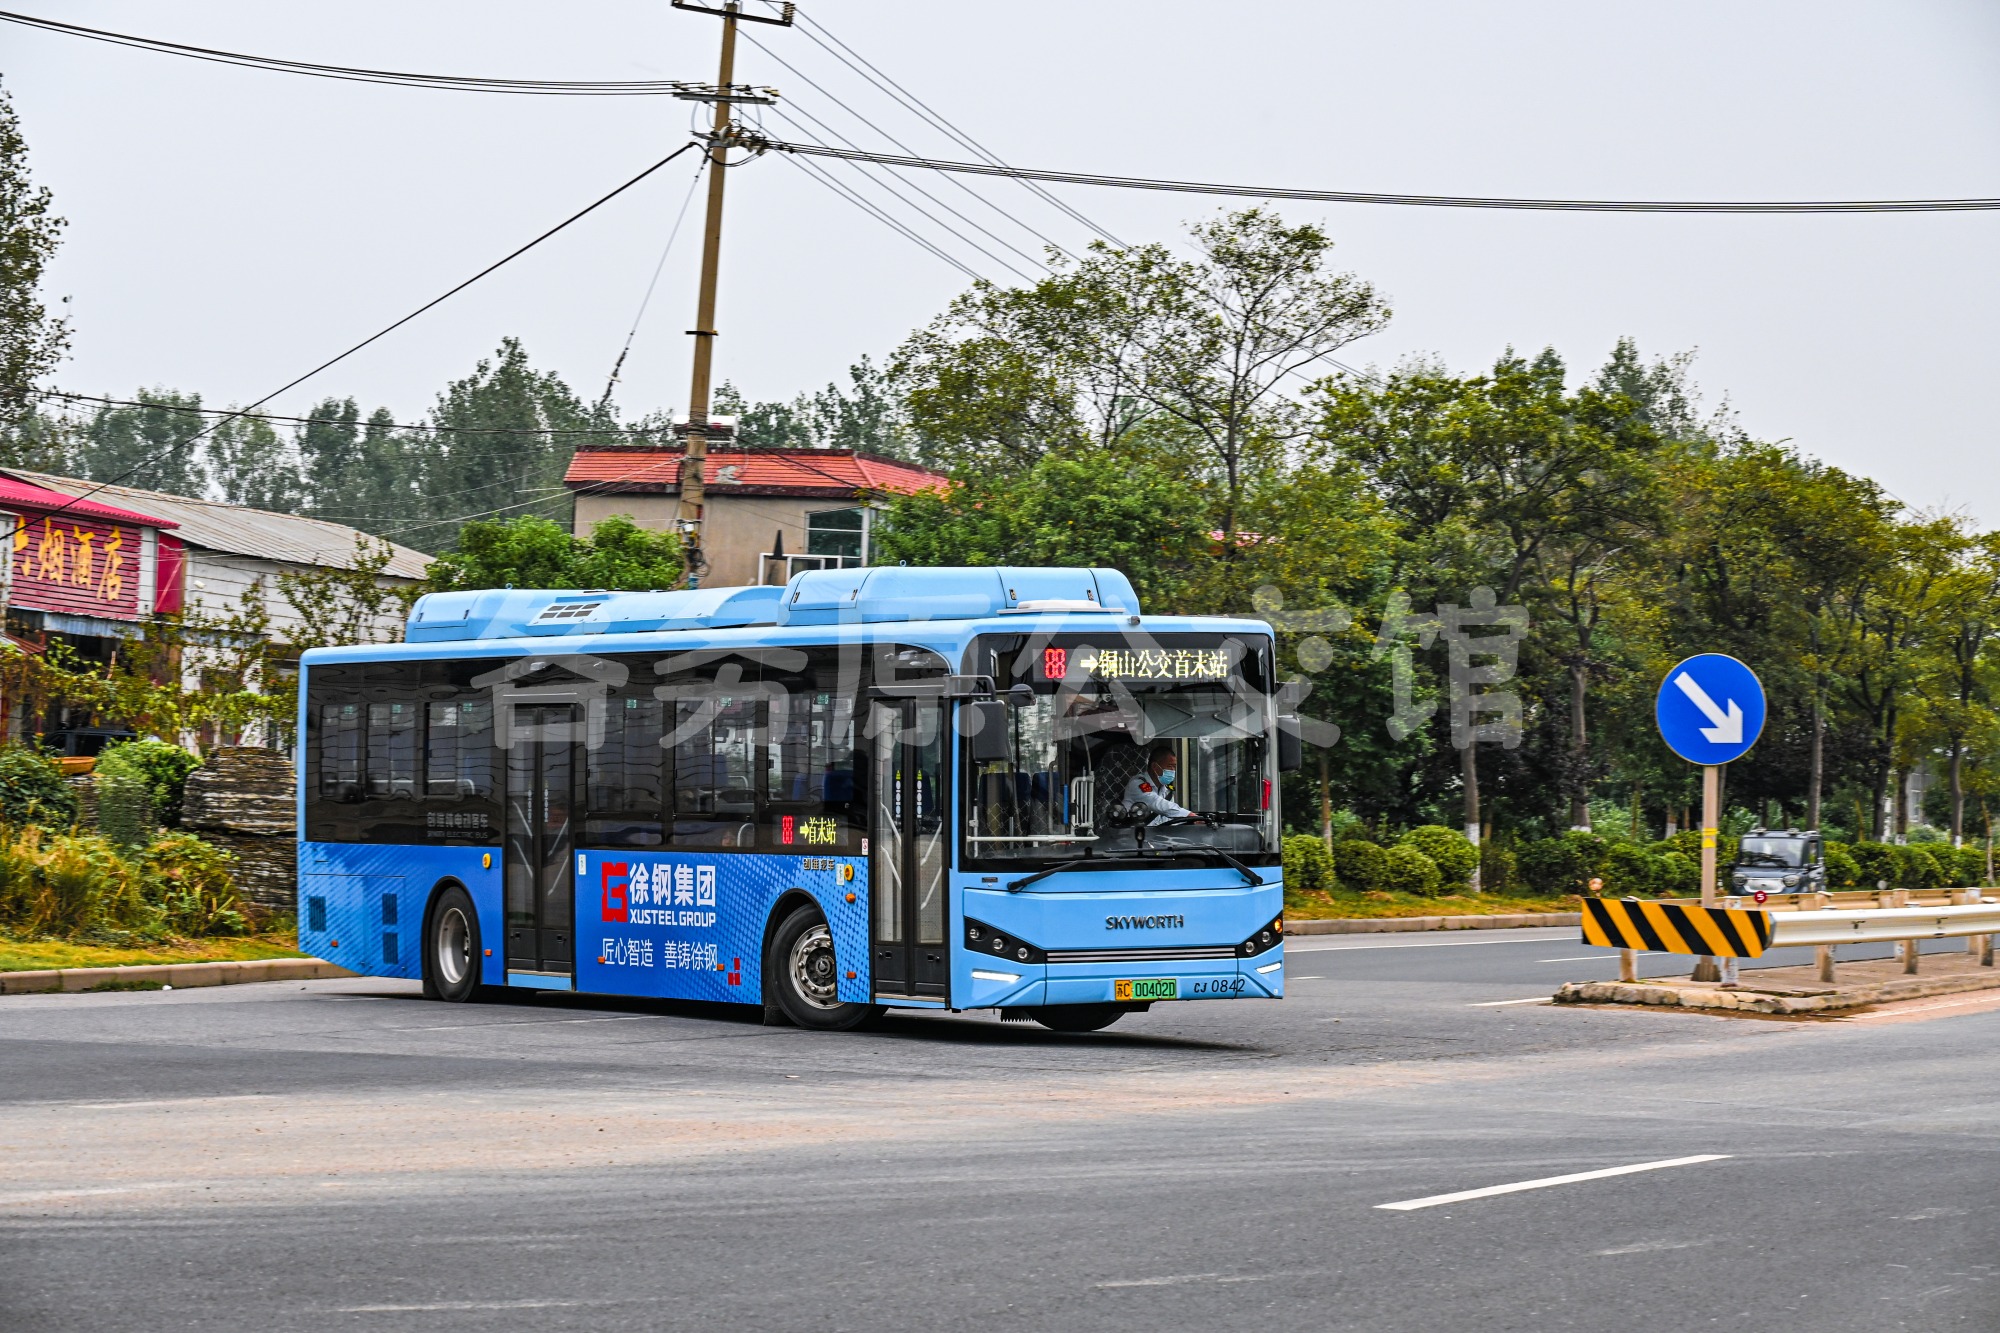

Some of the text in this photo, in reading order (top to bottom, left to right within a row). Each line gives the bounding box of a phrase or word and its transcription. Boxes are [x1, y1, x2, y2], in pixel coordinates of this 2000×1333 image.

[1045, 648, 1066, 679] 88
[782, 815, 793, 844] 88
[808, 817, 836, 844] 首末站
[629, 862, 716, 907] 徐钢集团
[629, 908, 716, 927] XUSTEEL GROUP
[1105, 914, 1184, 930] SKYWORTH
[603, 938, 718, 972] 匠心智造 善铸徐钢
[1211, 978, 1246, 993] 0842
